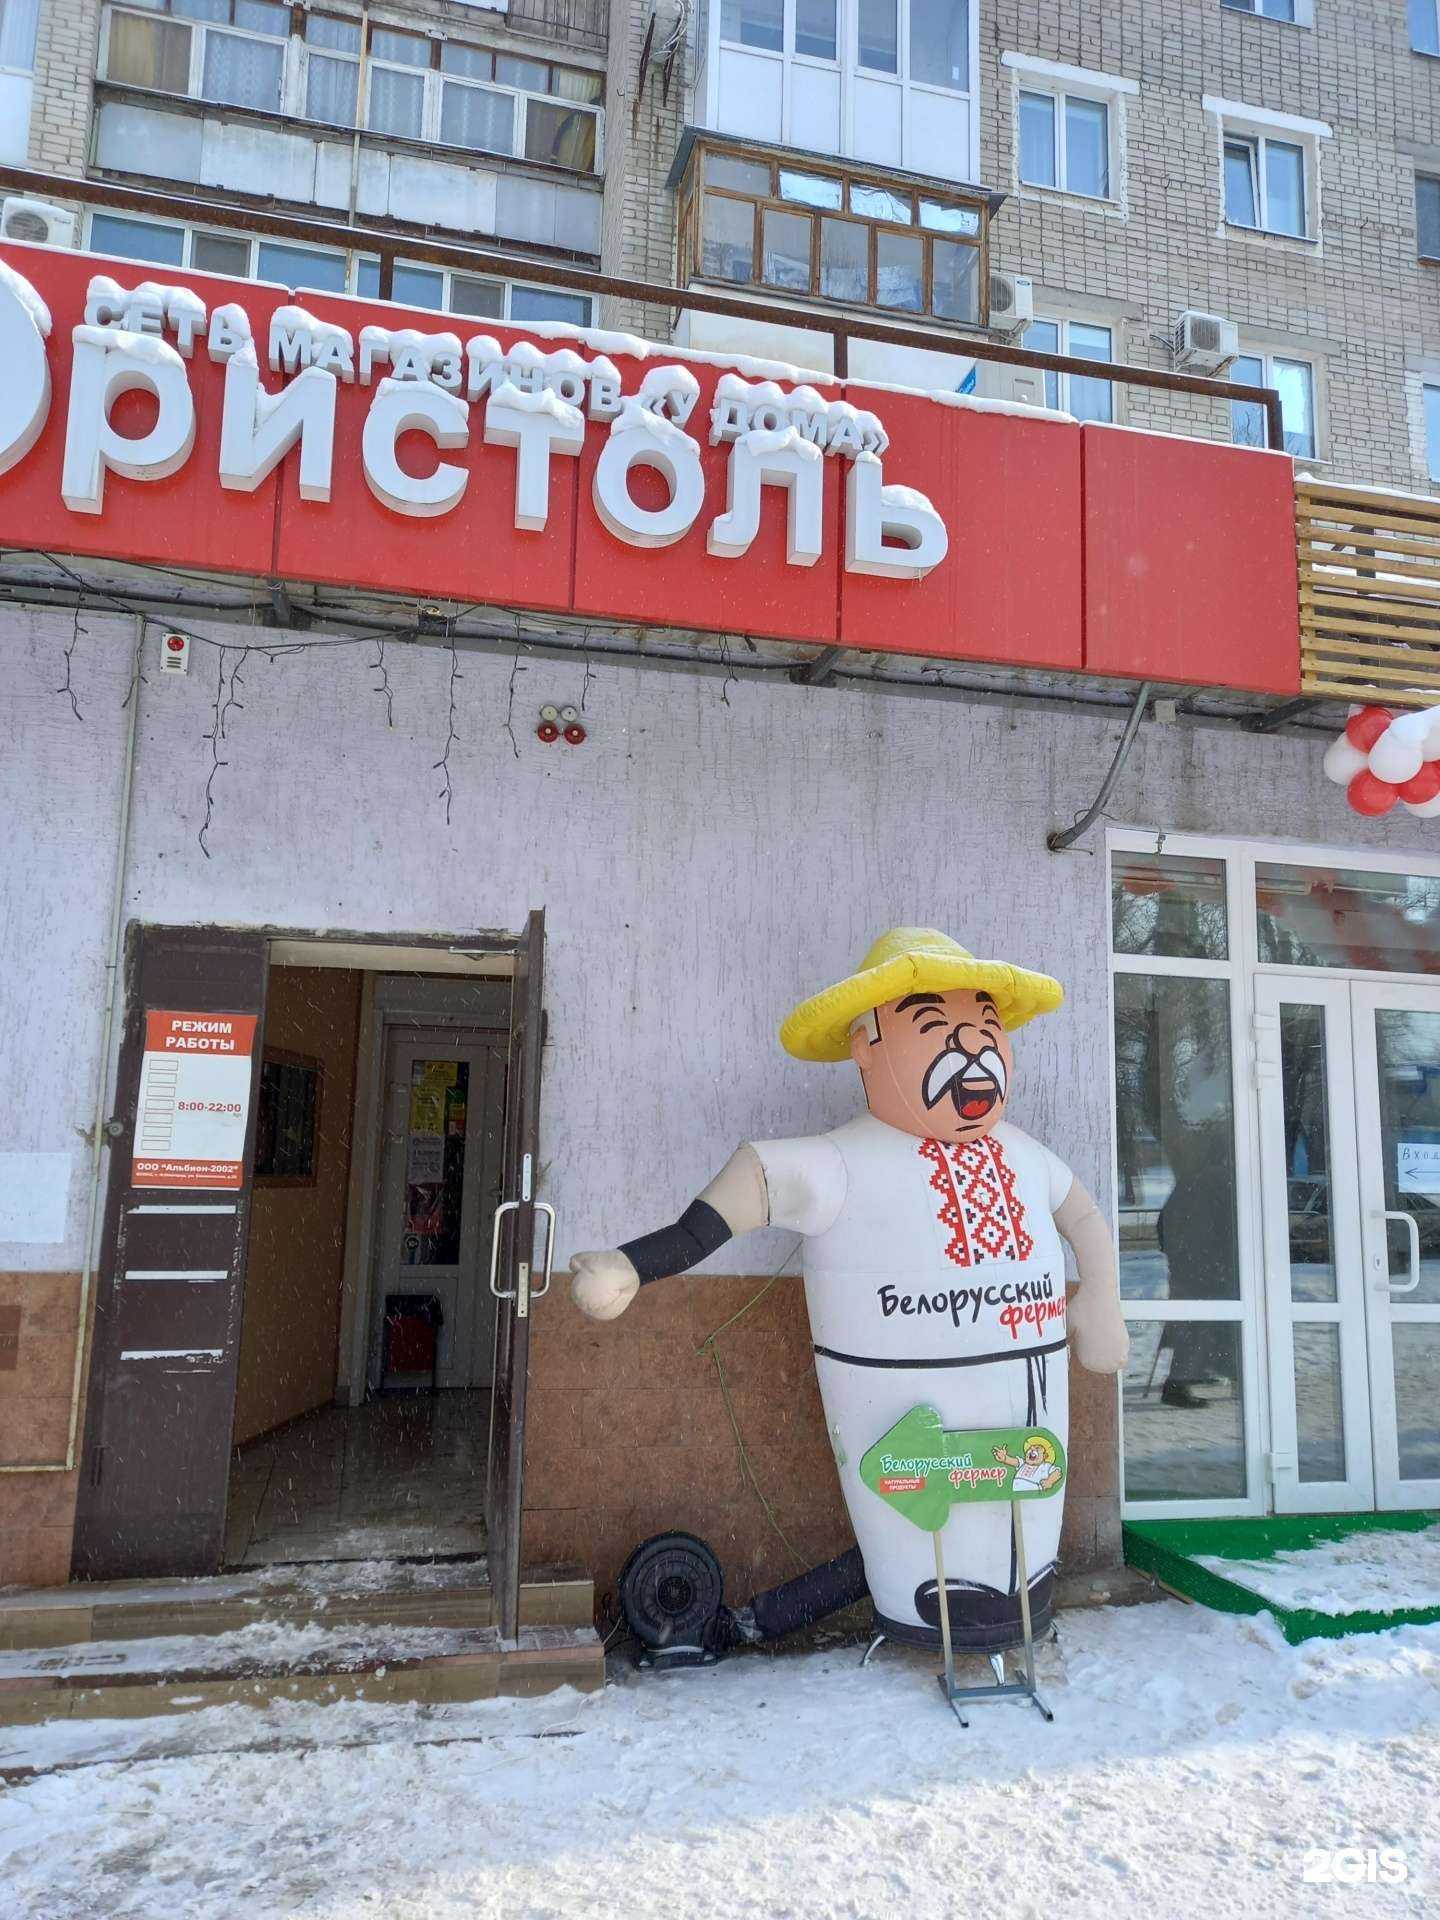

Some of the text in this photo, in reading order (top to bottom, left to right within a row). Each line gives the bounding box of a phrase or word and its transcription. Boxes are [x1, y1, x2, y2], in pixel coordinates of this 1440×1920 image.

[84, 279, 252, 362] СЕТЬ
[269, 310, 622, 421] МАГАЗИНОВ
[0, 258, 949, 580] ристоль
[171, 1020, 232, 1034] РЕЖИМ
[165, 1036, 235, 1050] РАБОТЫ
[178, 1101, 241, 1112] 8:00-22:00
[137, 1162, 159, 1171] ООО
[877, 1272, 1053, 1327] Белорусский
[880, 1453, 973, 1477] Белорусский
[948, 1468, 1007, 1489] фермер
